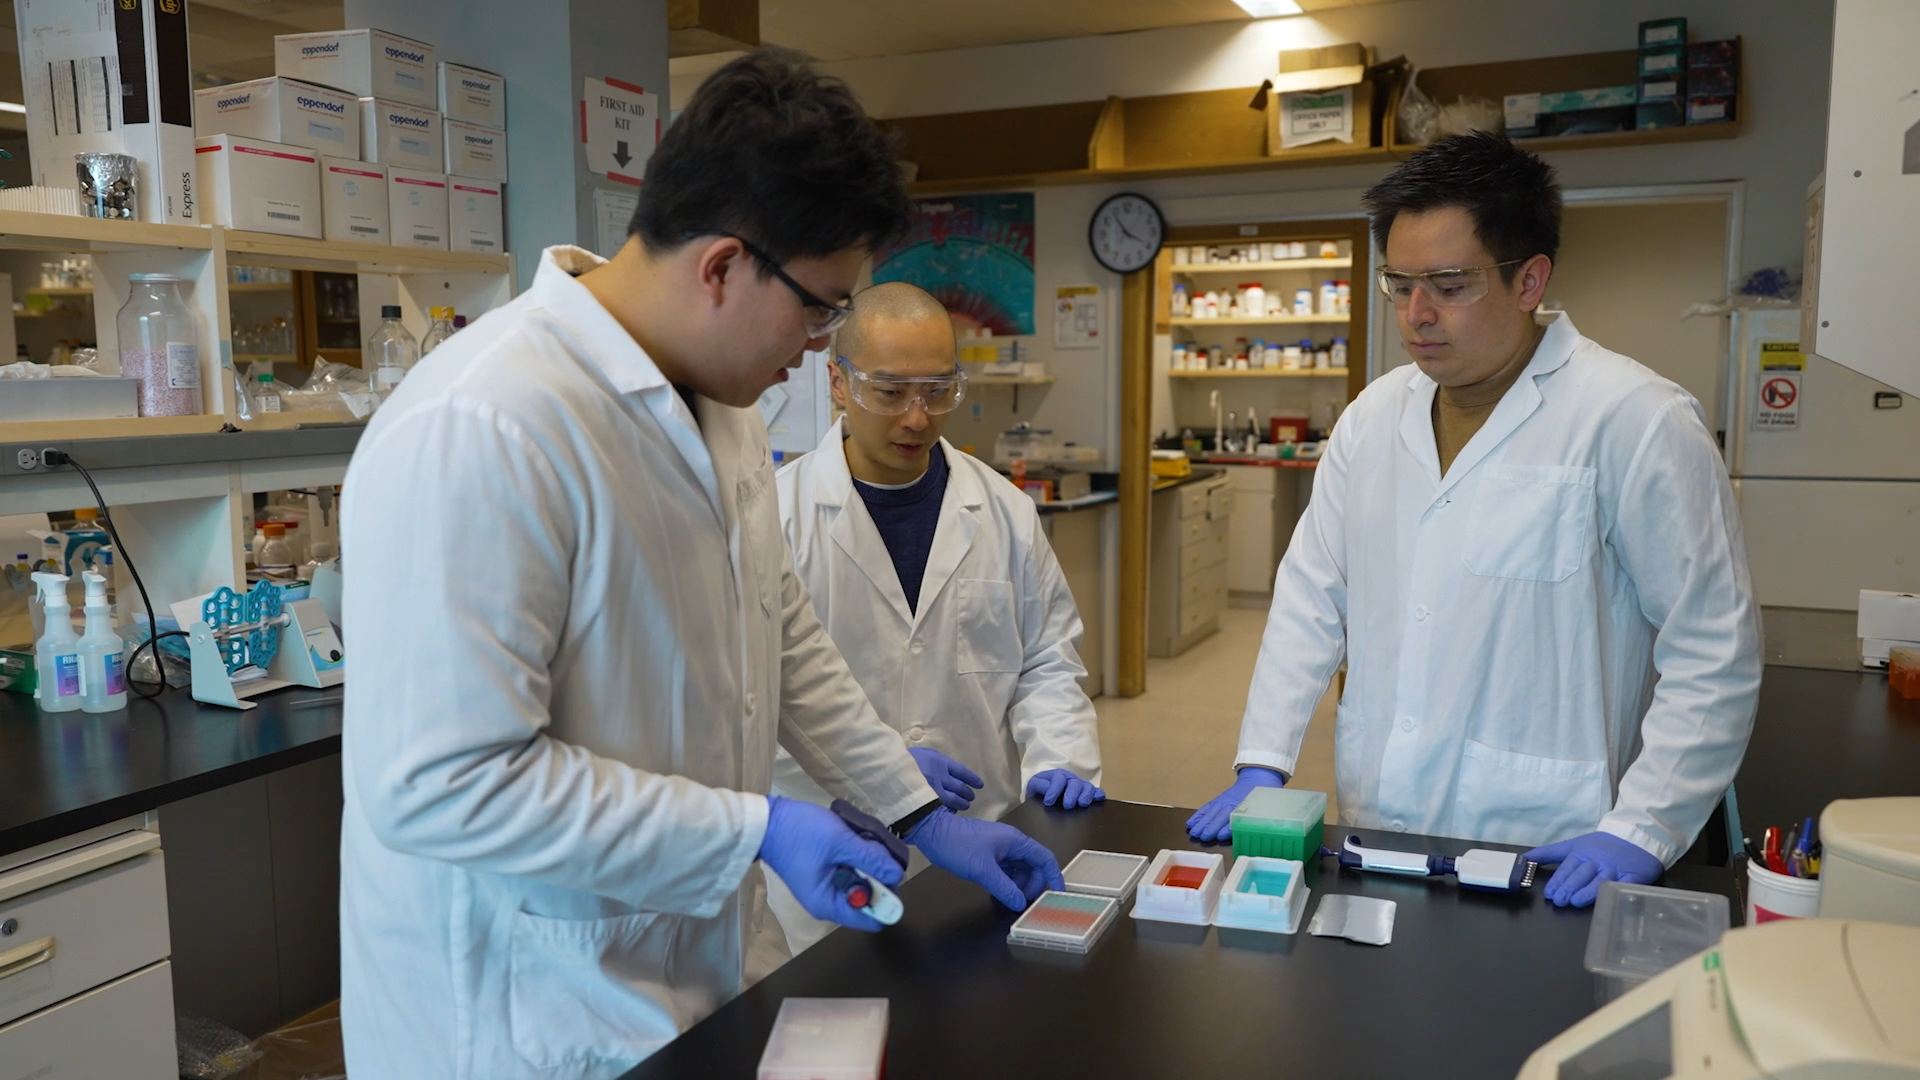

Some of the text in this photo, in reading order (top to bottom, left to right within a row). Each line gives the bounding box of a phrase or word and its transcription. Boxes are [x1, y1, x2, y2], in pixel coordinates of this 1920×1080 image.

[302, 42, 340, 55] eppendorf
[385, 46, 424, 63] eppendorf
[462, 79, 491, 91] eppendorf
[218, 93, 251, 108] eppendorf
[297, 96, 345, 113] eppendorf
[600, 96, 645, 117] FIRST AID
[389, 114, 429, 128] eppendorf
[1294, 110, 1341, 121] OFFICE PAPER
[615, 117, 631, 131] KIT
[1308, 121, 1326, 129] ONLY
[465, 135, 493, 145] eppendorf
[182, 172, 193, 219] Express
[1123, 202, 1132, 213] 12
[1147, 214, 1153, 225] 2
[1151, 227, 1157, 238] 3
[1146, 242, 1152, 250] 4
[1112, 251, 1119, 261] 7
[1124, 253, 1131, 265] 6
[1137, 250, 1143, 260] 5
